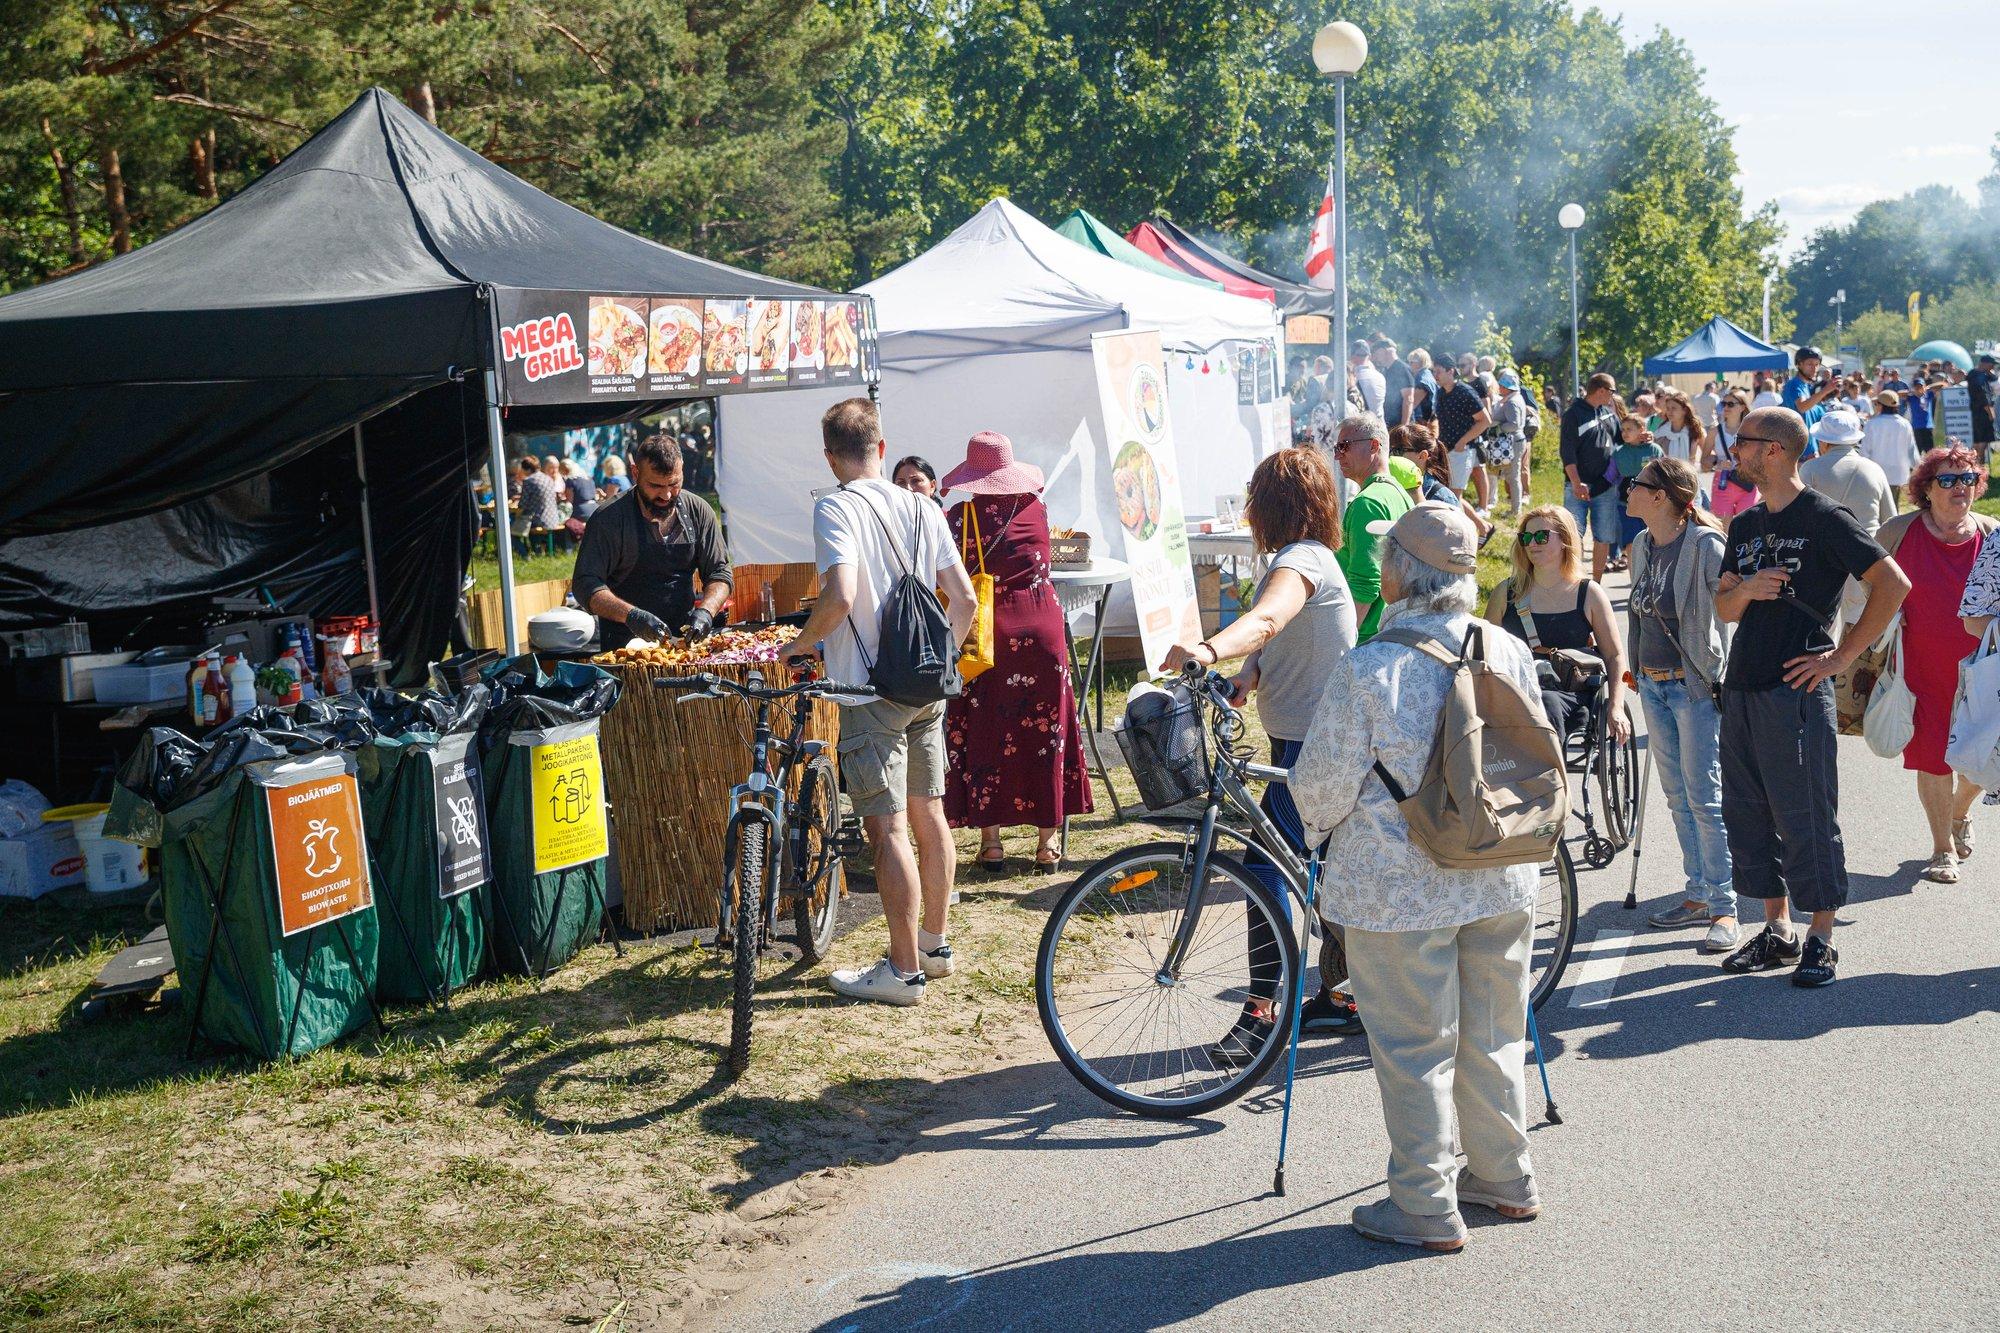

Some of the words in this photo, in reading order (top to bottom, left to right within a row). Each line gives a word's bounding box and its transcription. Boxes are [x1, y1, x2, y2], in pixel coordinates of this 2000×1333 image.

[502, 315, 574, 357] MEGA
[542, 754, 593, 771] JOOGIKARTONG
[287, 783, 342, 807] BIOJÄÄTMED
[301, 878, 351, 901] БИООТХОДЫ
[308, 893, 348, 914] BIOWASTE
